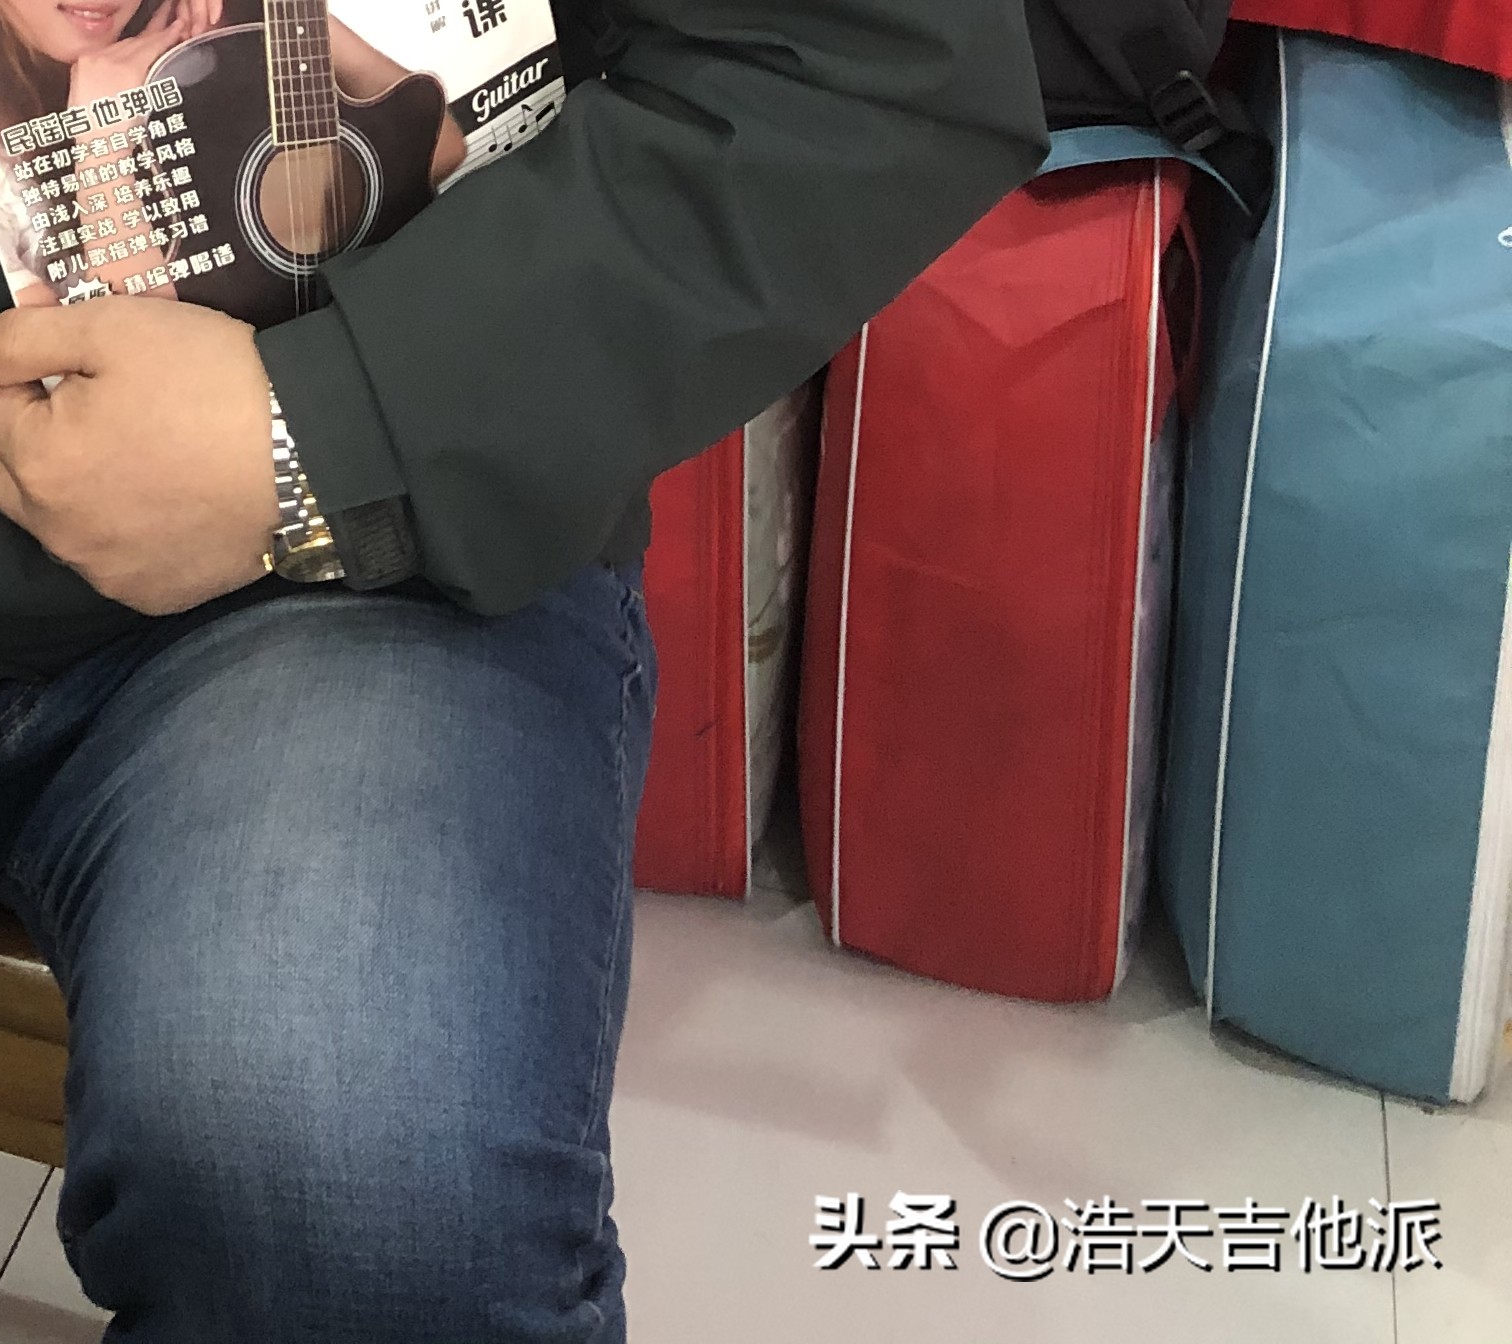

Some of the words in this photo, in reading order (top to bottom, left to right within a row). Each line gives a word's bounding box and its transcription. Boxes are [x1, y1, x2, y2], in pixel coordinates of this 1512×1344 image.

[1, 77, 183, 156] 民谣吉他弹唱
[471, 57, 549, 123] Guitar
[13, 112, 188, 182] 站在初学者自学角度
[22, 137, 197, 206] 独特易懂的教学风格
[31, 193, 109, 232] 由浅入深
[112, 165, 193, 205] 培养乐趣
[39, 217, 117, 257] 注重实战
[122, 190, 201, 229] 学以致用
[47, 213, 210, 283] 附儿歌指弹练习谱
[123, 243, 236, 296] 精编弹唱谱
